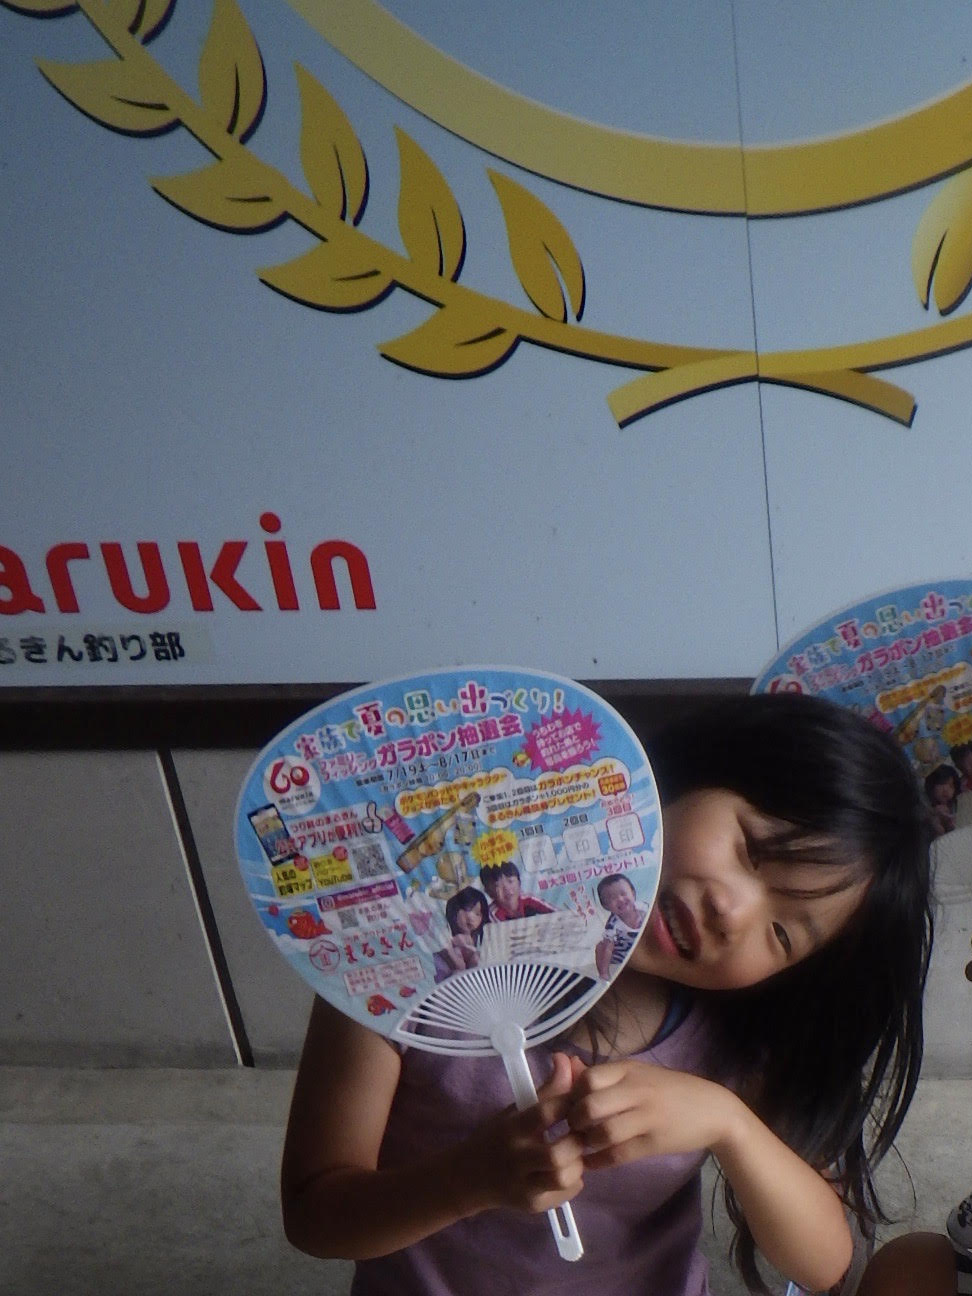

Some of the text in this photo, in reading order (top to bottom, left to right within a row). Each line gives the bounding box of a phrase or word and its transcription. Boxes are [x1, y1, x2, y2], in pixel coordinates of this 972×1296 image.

[295, 681, 565, 761] 家族で夏の思い出づくり!
[376, 713, 524, 767] ガラポン抽選会
[519, 825, 544, 838] 1回目
[563, 813, 589, 827] 2回目
[345, 931, 414, 964] まるきん
